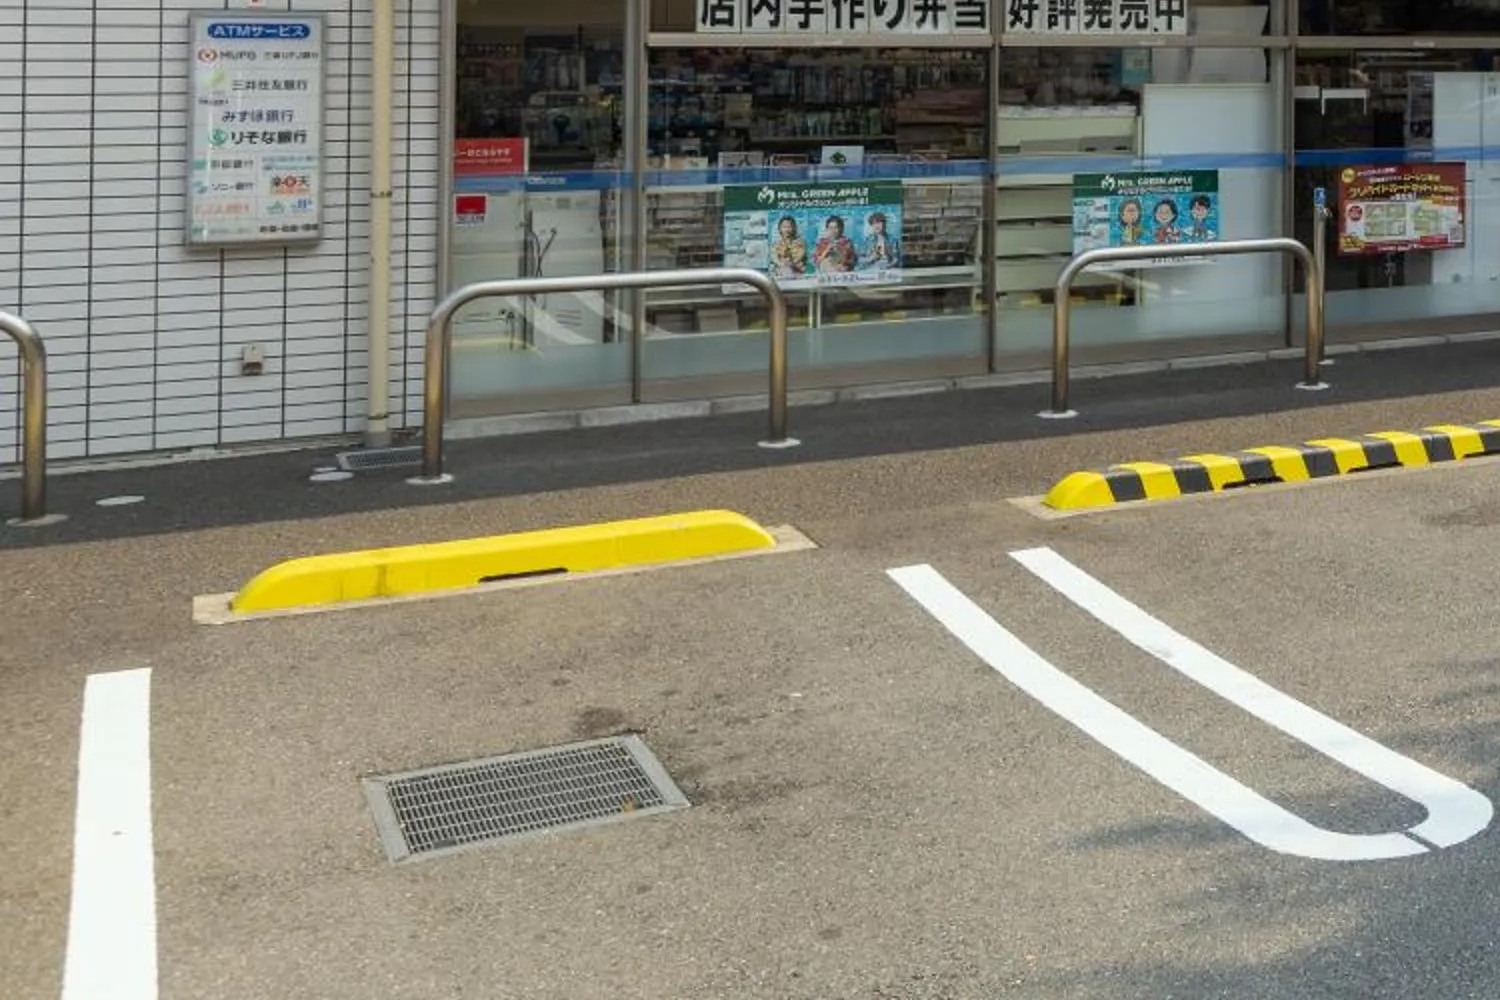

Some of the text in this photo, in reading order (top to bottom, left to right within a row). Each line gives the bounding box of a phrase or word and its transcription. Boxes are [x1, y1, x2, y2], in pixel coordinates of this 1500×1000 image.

[214, 25, 305, 37] ATMサービス
[222, 109, 294, 122] みずほ銀行
[231, 130, 308, 144] りそな銀行
